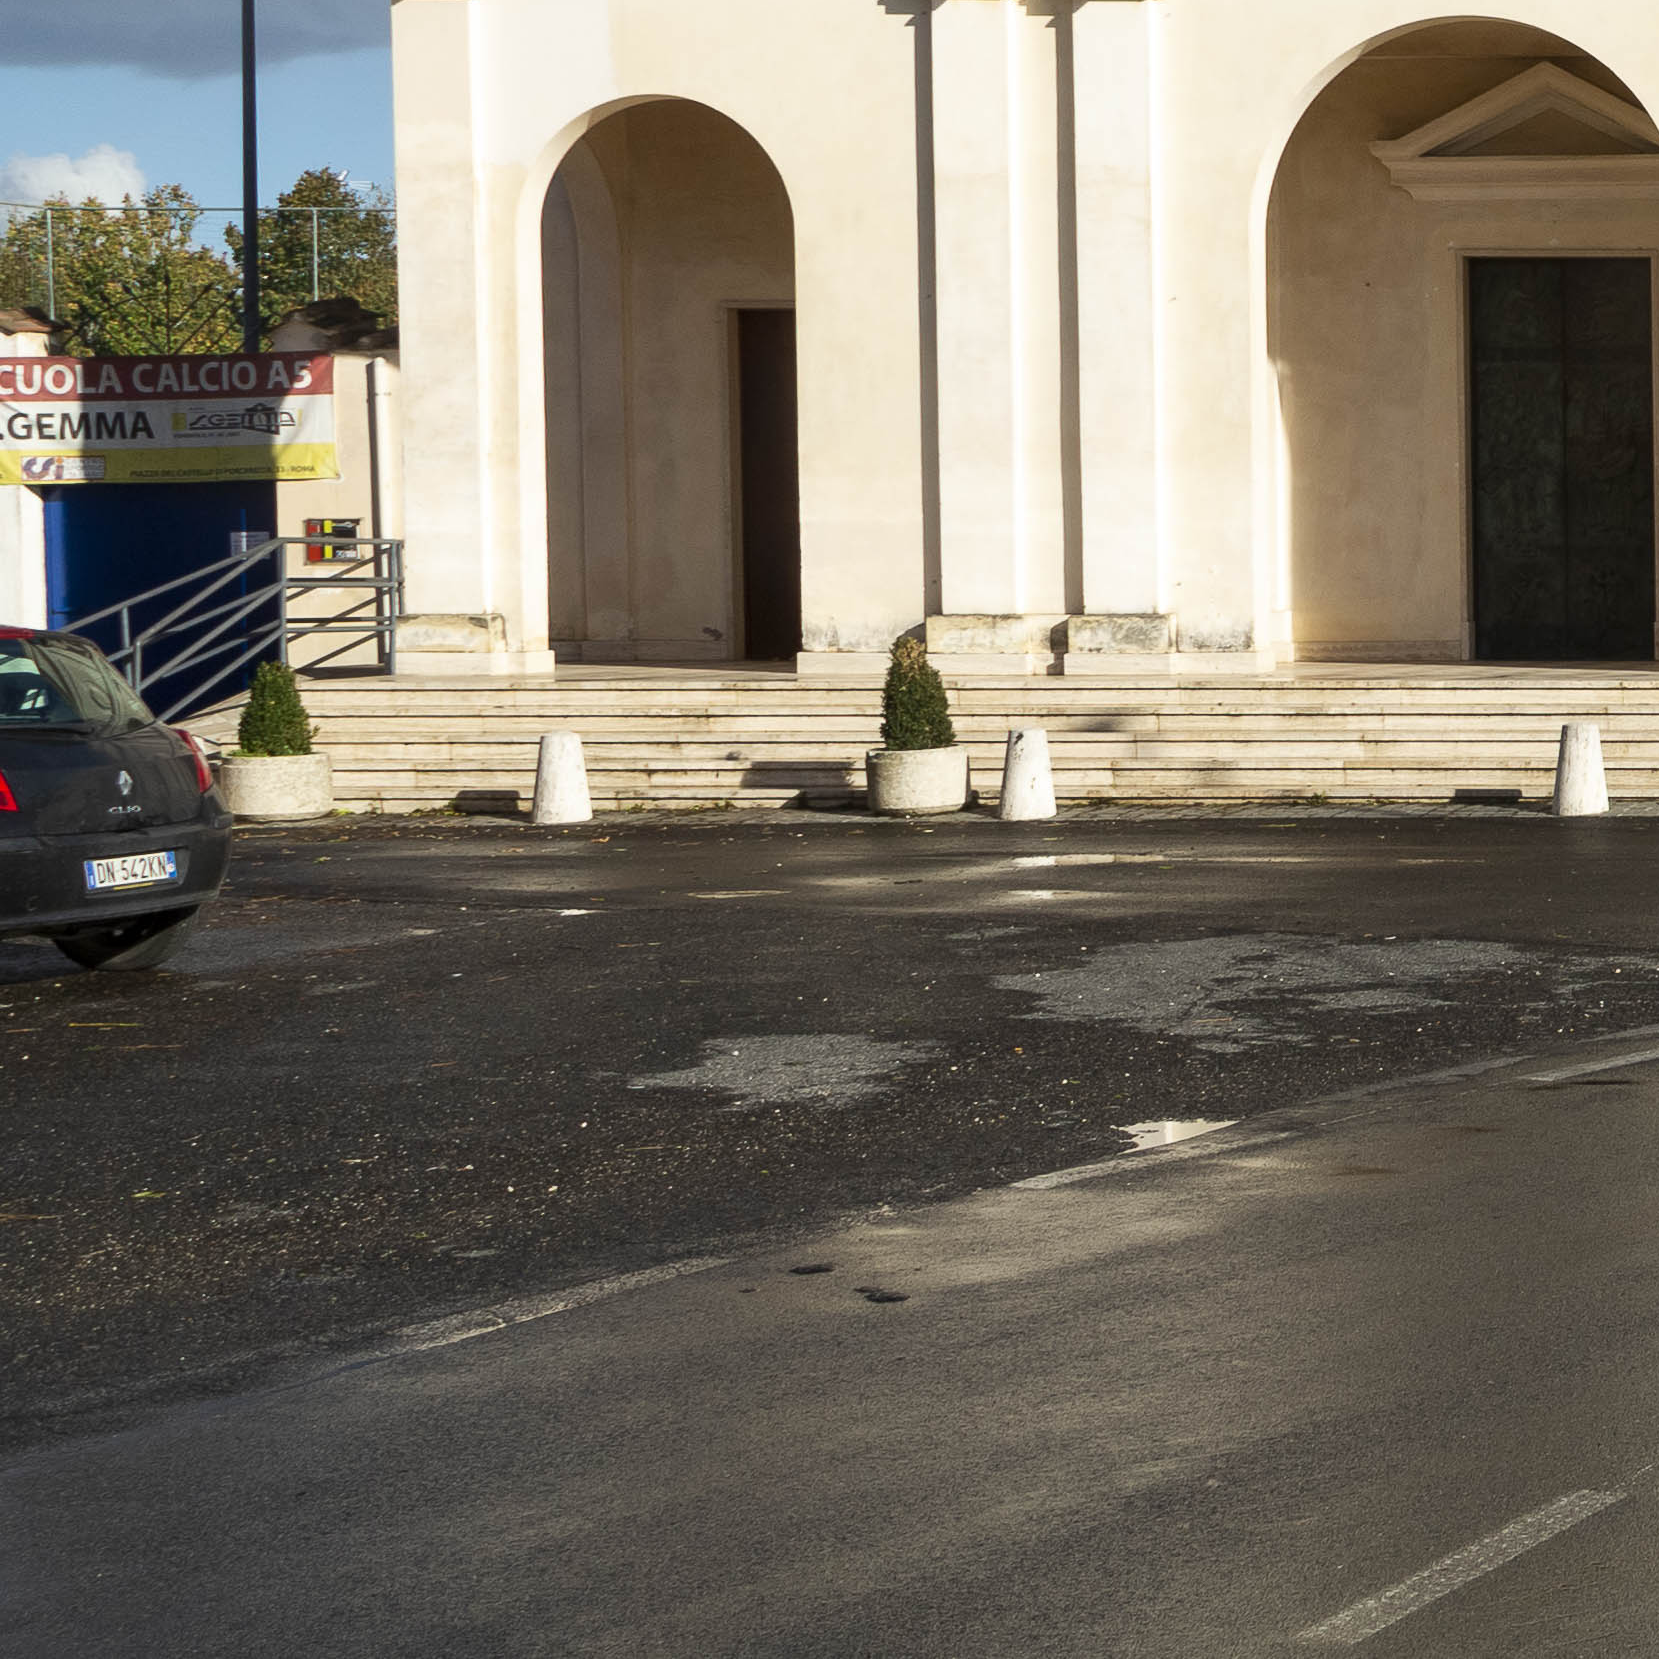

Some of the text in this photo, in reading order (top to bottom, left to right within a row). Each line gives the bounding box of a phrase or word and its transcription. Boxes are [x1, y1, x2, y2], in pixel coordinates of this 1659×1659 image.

[132, 360, 258, 394] CALCIO
[266, 358, 313, 390] A5
[107, 805, 142, 814] CLIO
